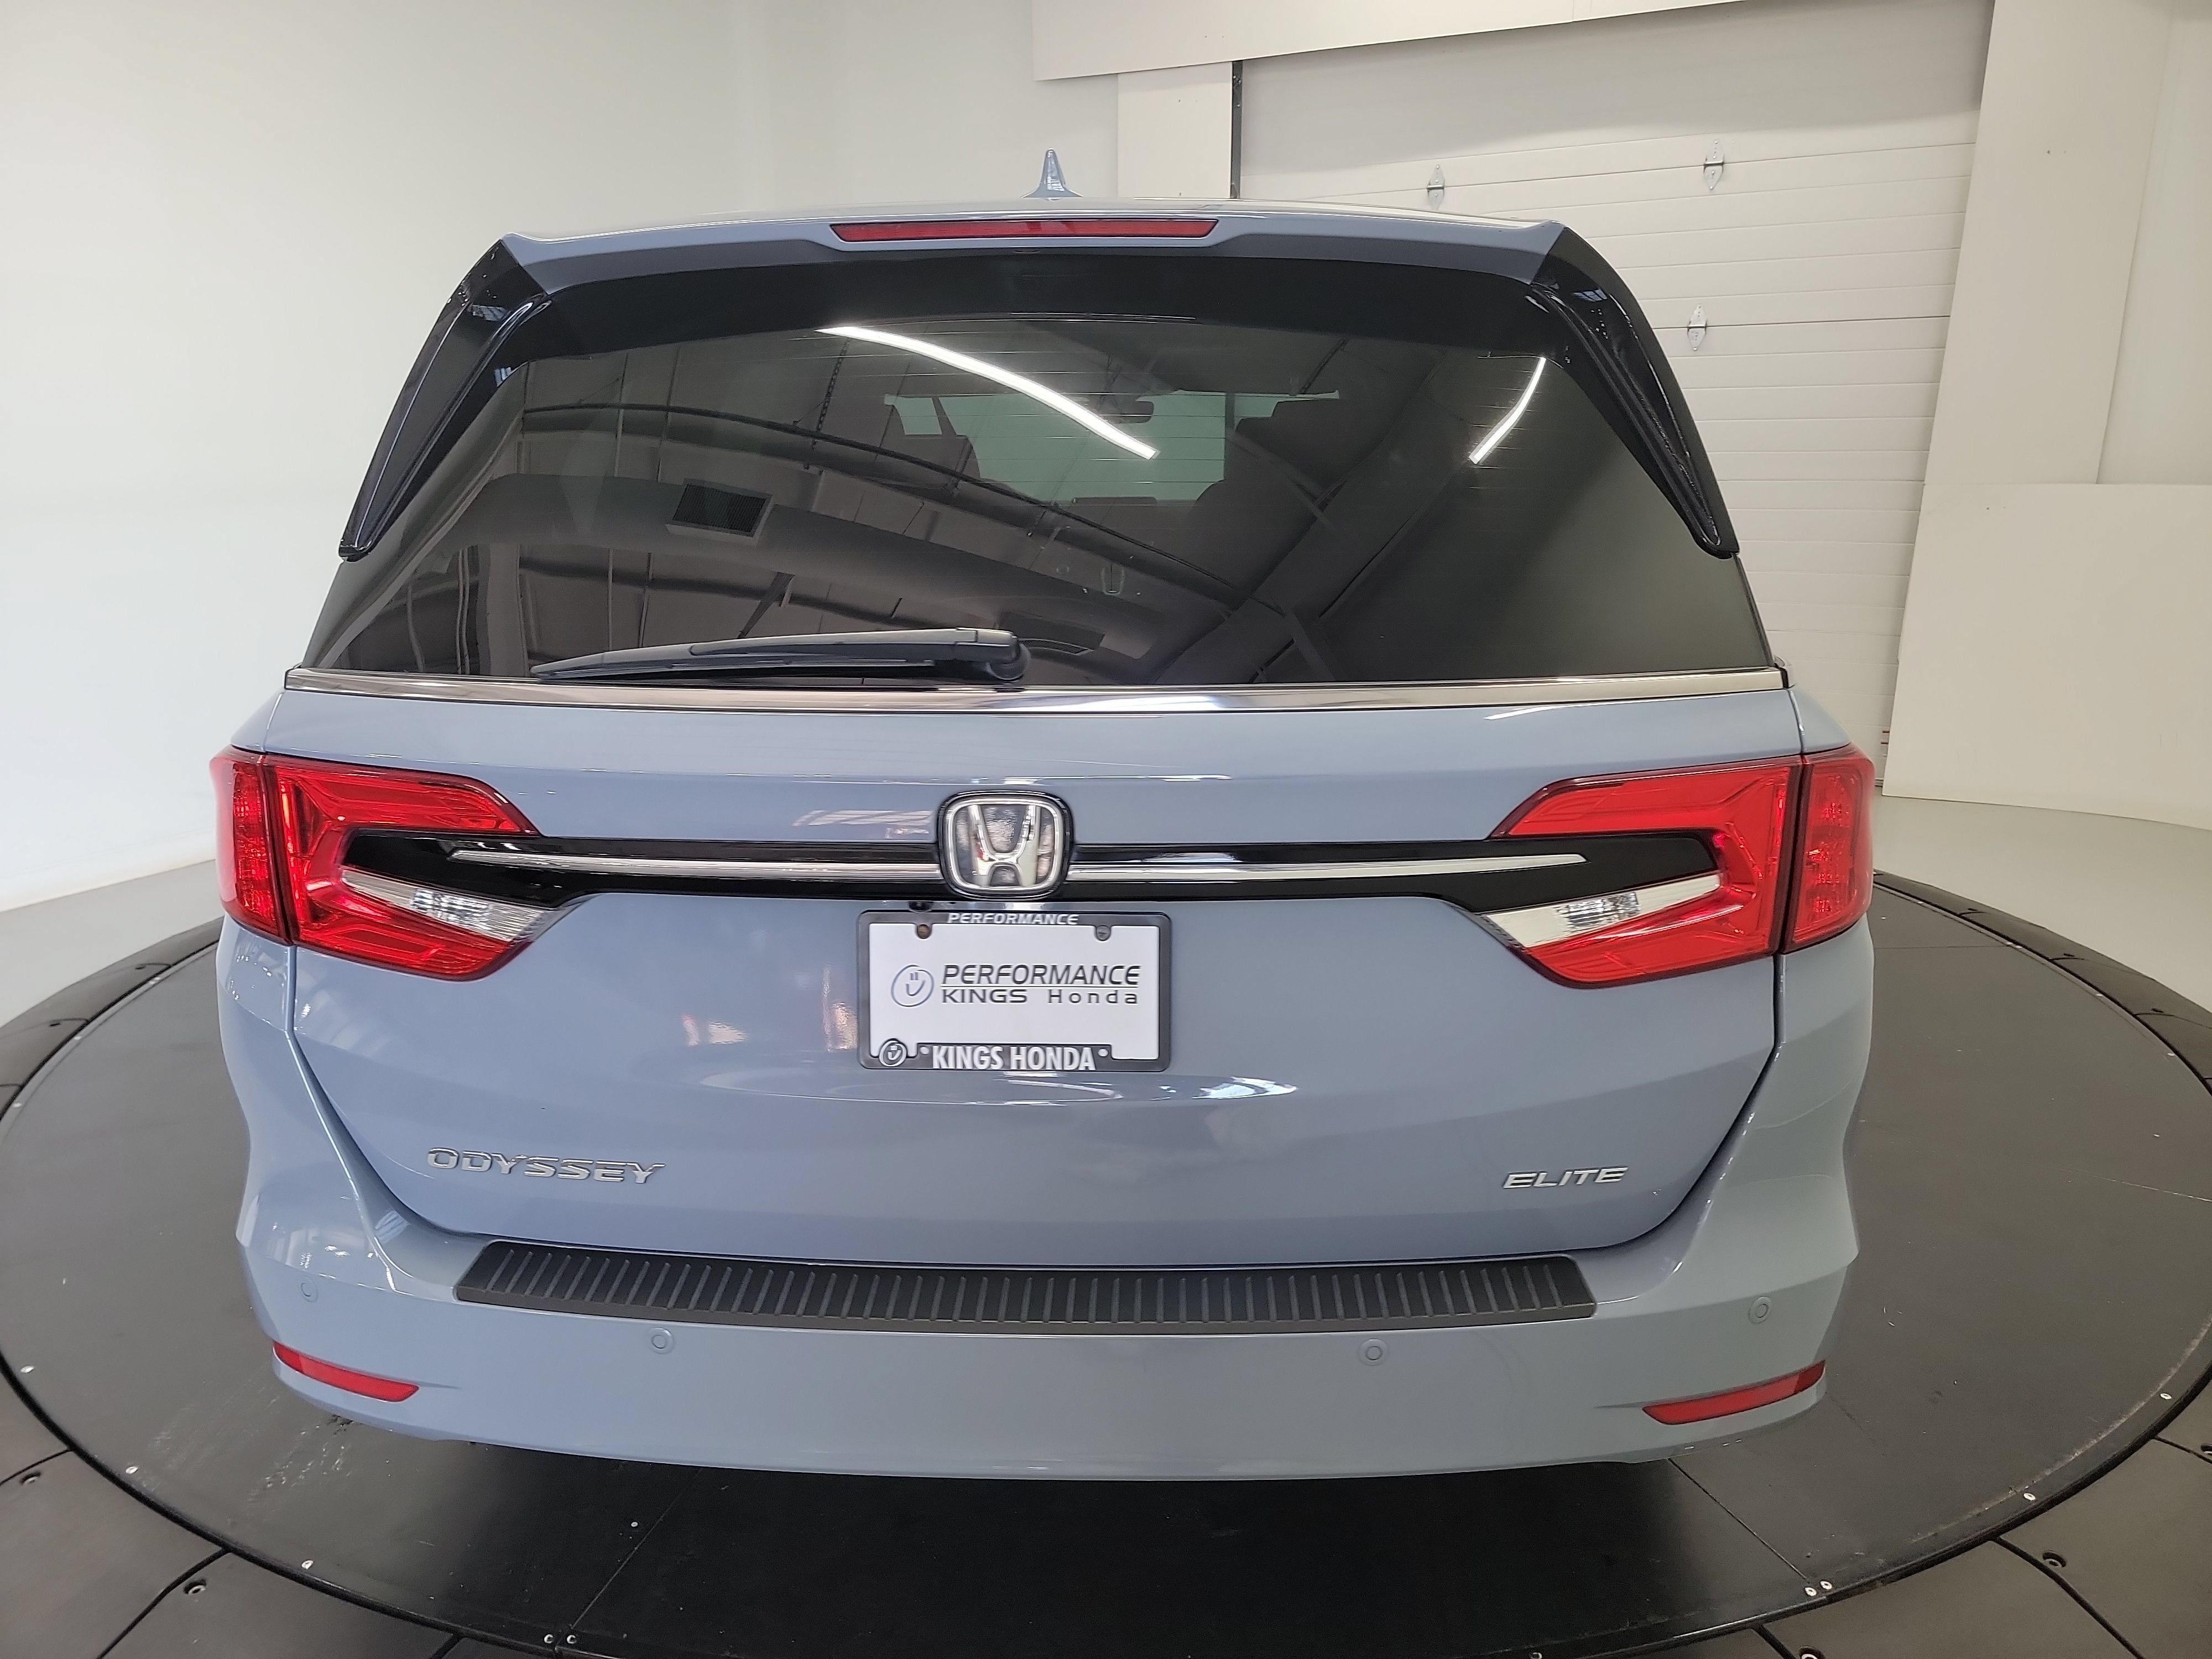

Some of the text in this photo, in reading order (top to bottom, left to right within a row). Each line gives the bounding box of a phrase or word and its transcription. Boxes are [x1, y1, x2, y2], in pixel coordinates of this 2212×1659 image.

[947, 912, 1080, 925] PERFORMANCE
[942, 964, 1141, 985] PERFORMANCE
[942, 989, 1139, 1004] KINGS Honda
[932, 1045, 1097, 1071] KINGS HONDA
[427, 1147, 665, 1184] ODYSSEY
[1503, 1166, 1629, 1189] ELITE
